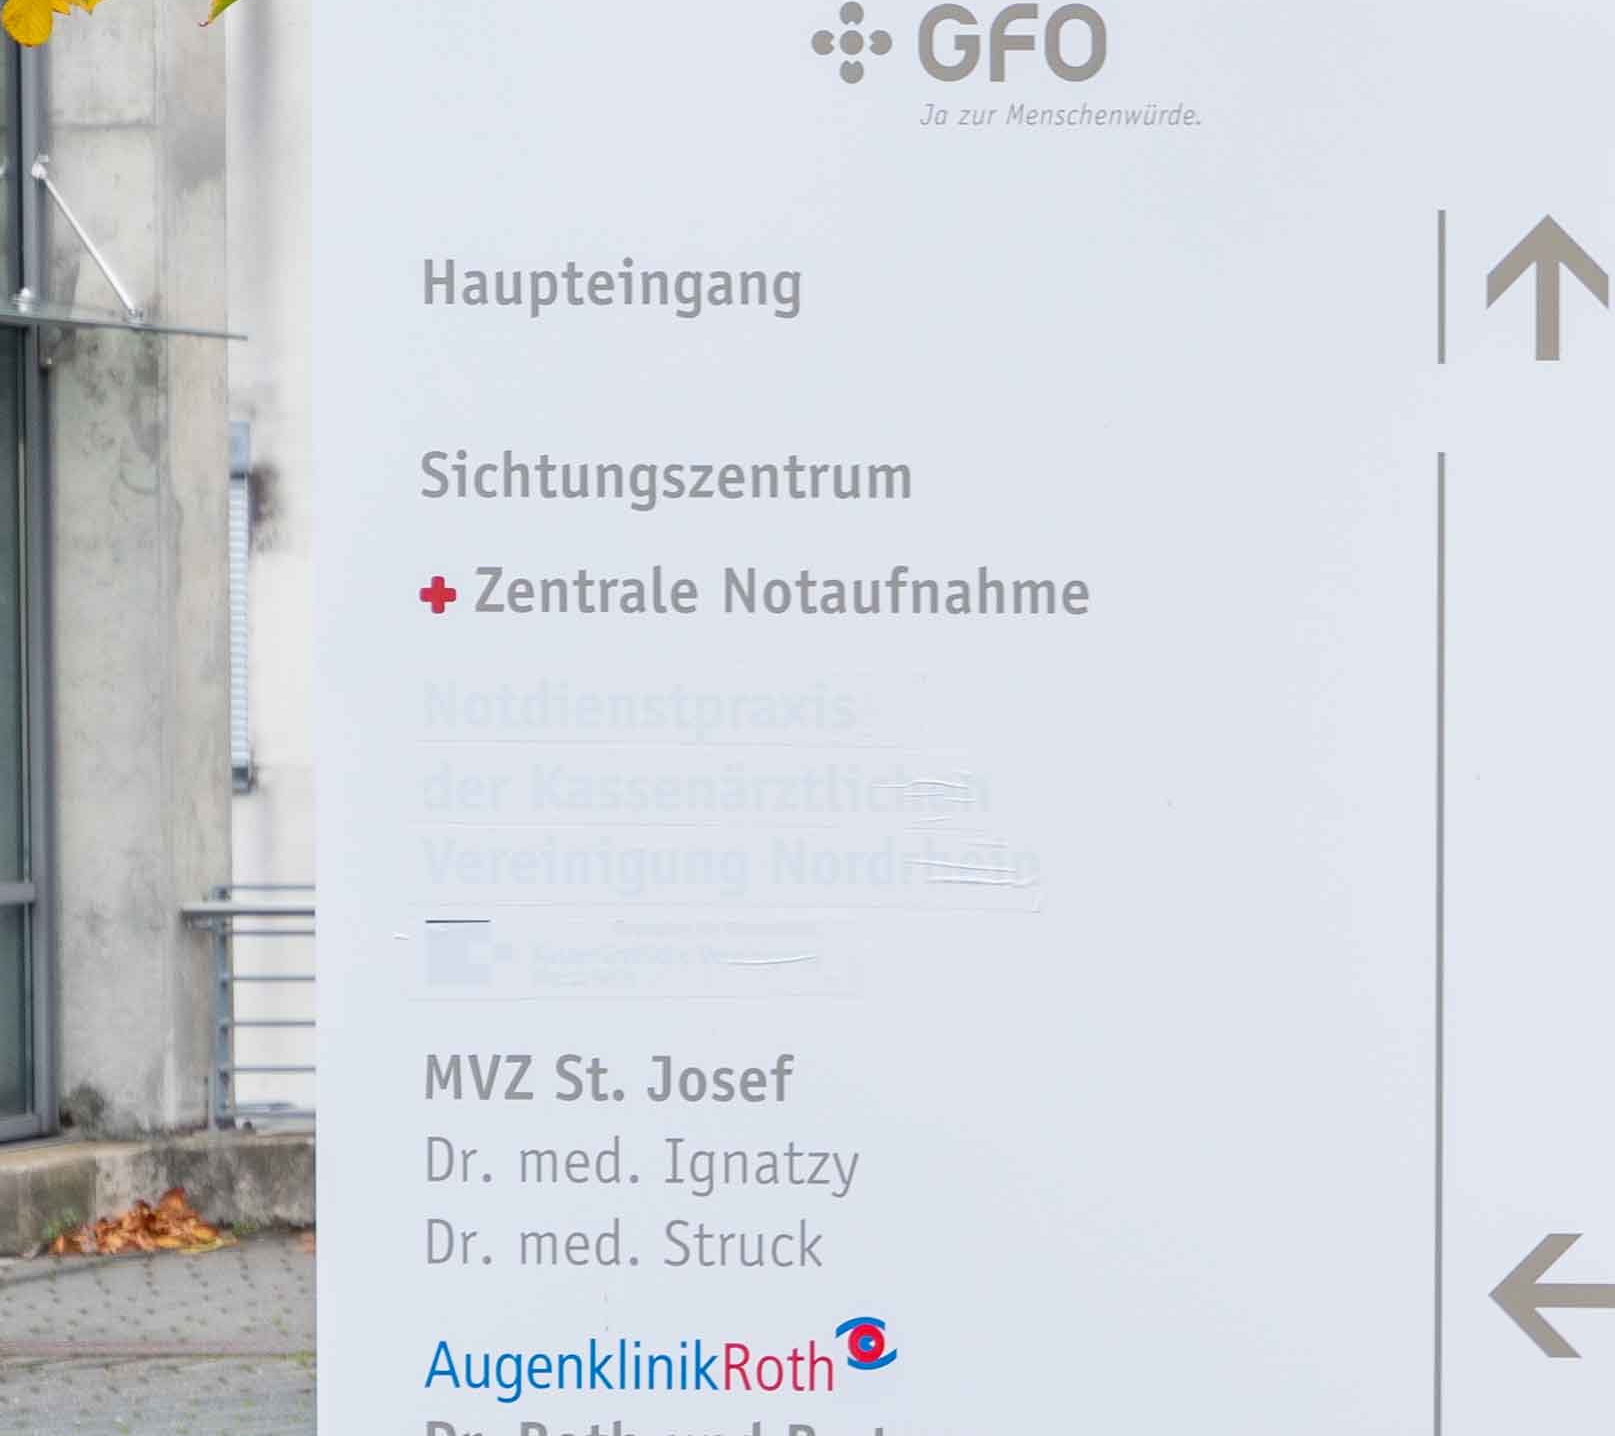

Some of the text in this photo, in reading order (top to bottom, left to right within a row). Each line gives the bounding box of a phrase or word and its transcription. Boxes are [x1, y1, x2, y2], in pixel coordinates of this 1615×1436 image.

[917, 2, 1108, 84] GFO
[919, 102, 1201, 127] Ja zur Menschenwürde.
[423, 256, 802, 319] Haupteingang
[420, 449, 911, 512] Sichtungszentrum
[474, 564, 1090, 616] Zentrale Notaufnahme
[425, 1053, 795, 1103] MVZ St. Josef
[426, 1134, 860, 1199] Dr. med. Ignatzy
[426, 1217, 823, 1268] Dr. med. Struck
[424, 1337, 834, 1404] AugenklinikRoth
